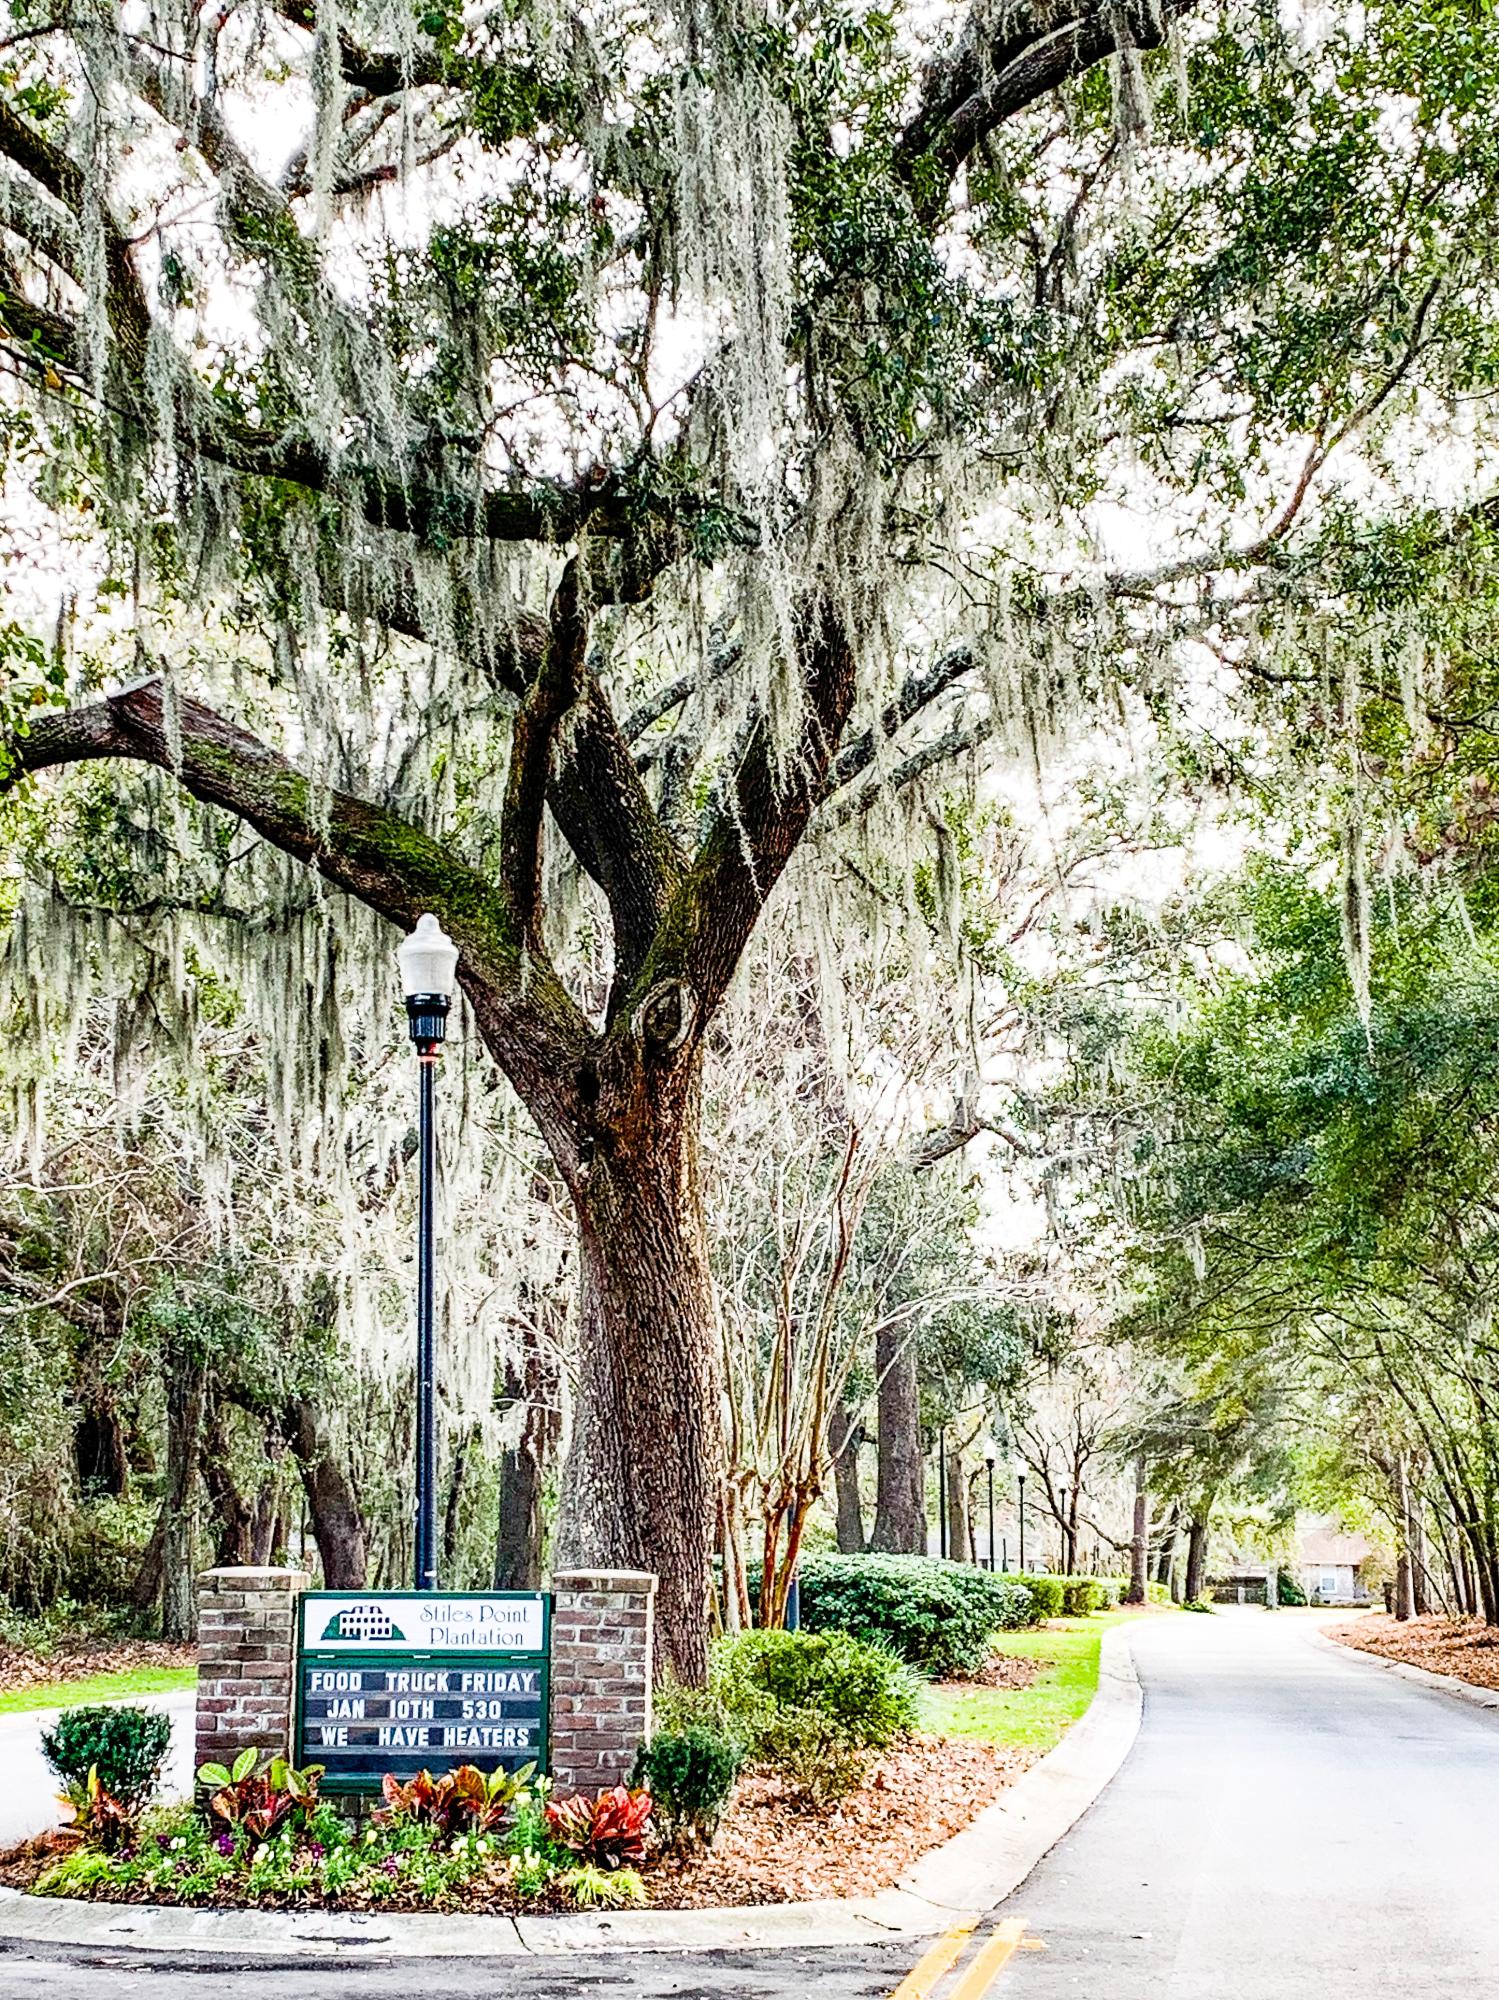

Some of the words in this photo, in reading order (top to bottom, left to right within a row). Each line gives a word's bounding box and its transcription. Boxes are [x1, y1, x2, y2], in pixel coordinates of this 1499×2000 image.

[419, 1604, 473, 1623] Stiles
[479, 1604, 530, 1623] Point
[430, 1627, 524, 1646] Plantation
[311, 1672, 362, 1692] FOOD
[385, 1672, 449, 1692] TRUCK
[461, 1672, 534, 1692] FRIDAY
[327, 1699, 365, 1719] JAN
[389, 1699, 434, 1719] 10TH
[462, 1700, 502, 1719] 530
[321, 1726, 348, 1746] WE
[378, 1727, 430, 1746] HAVE
[443, 1727, 529, 1746] HEATERS
